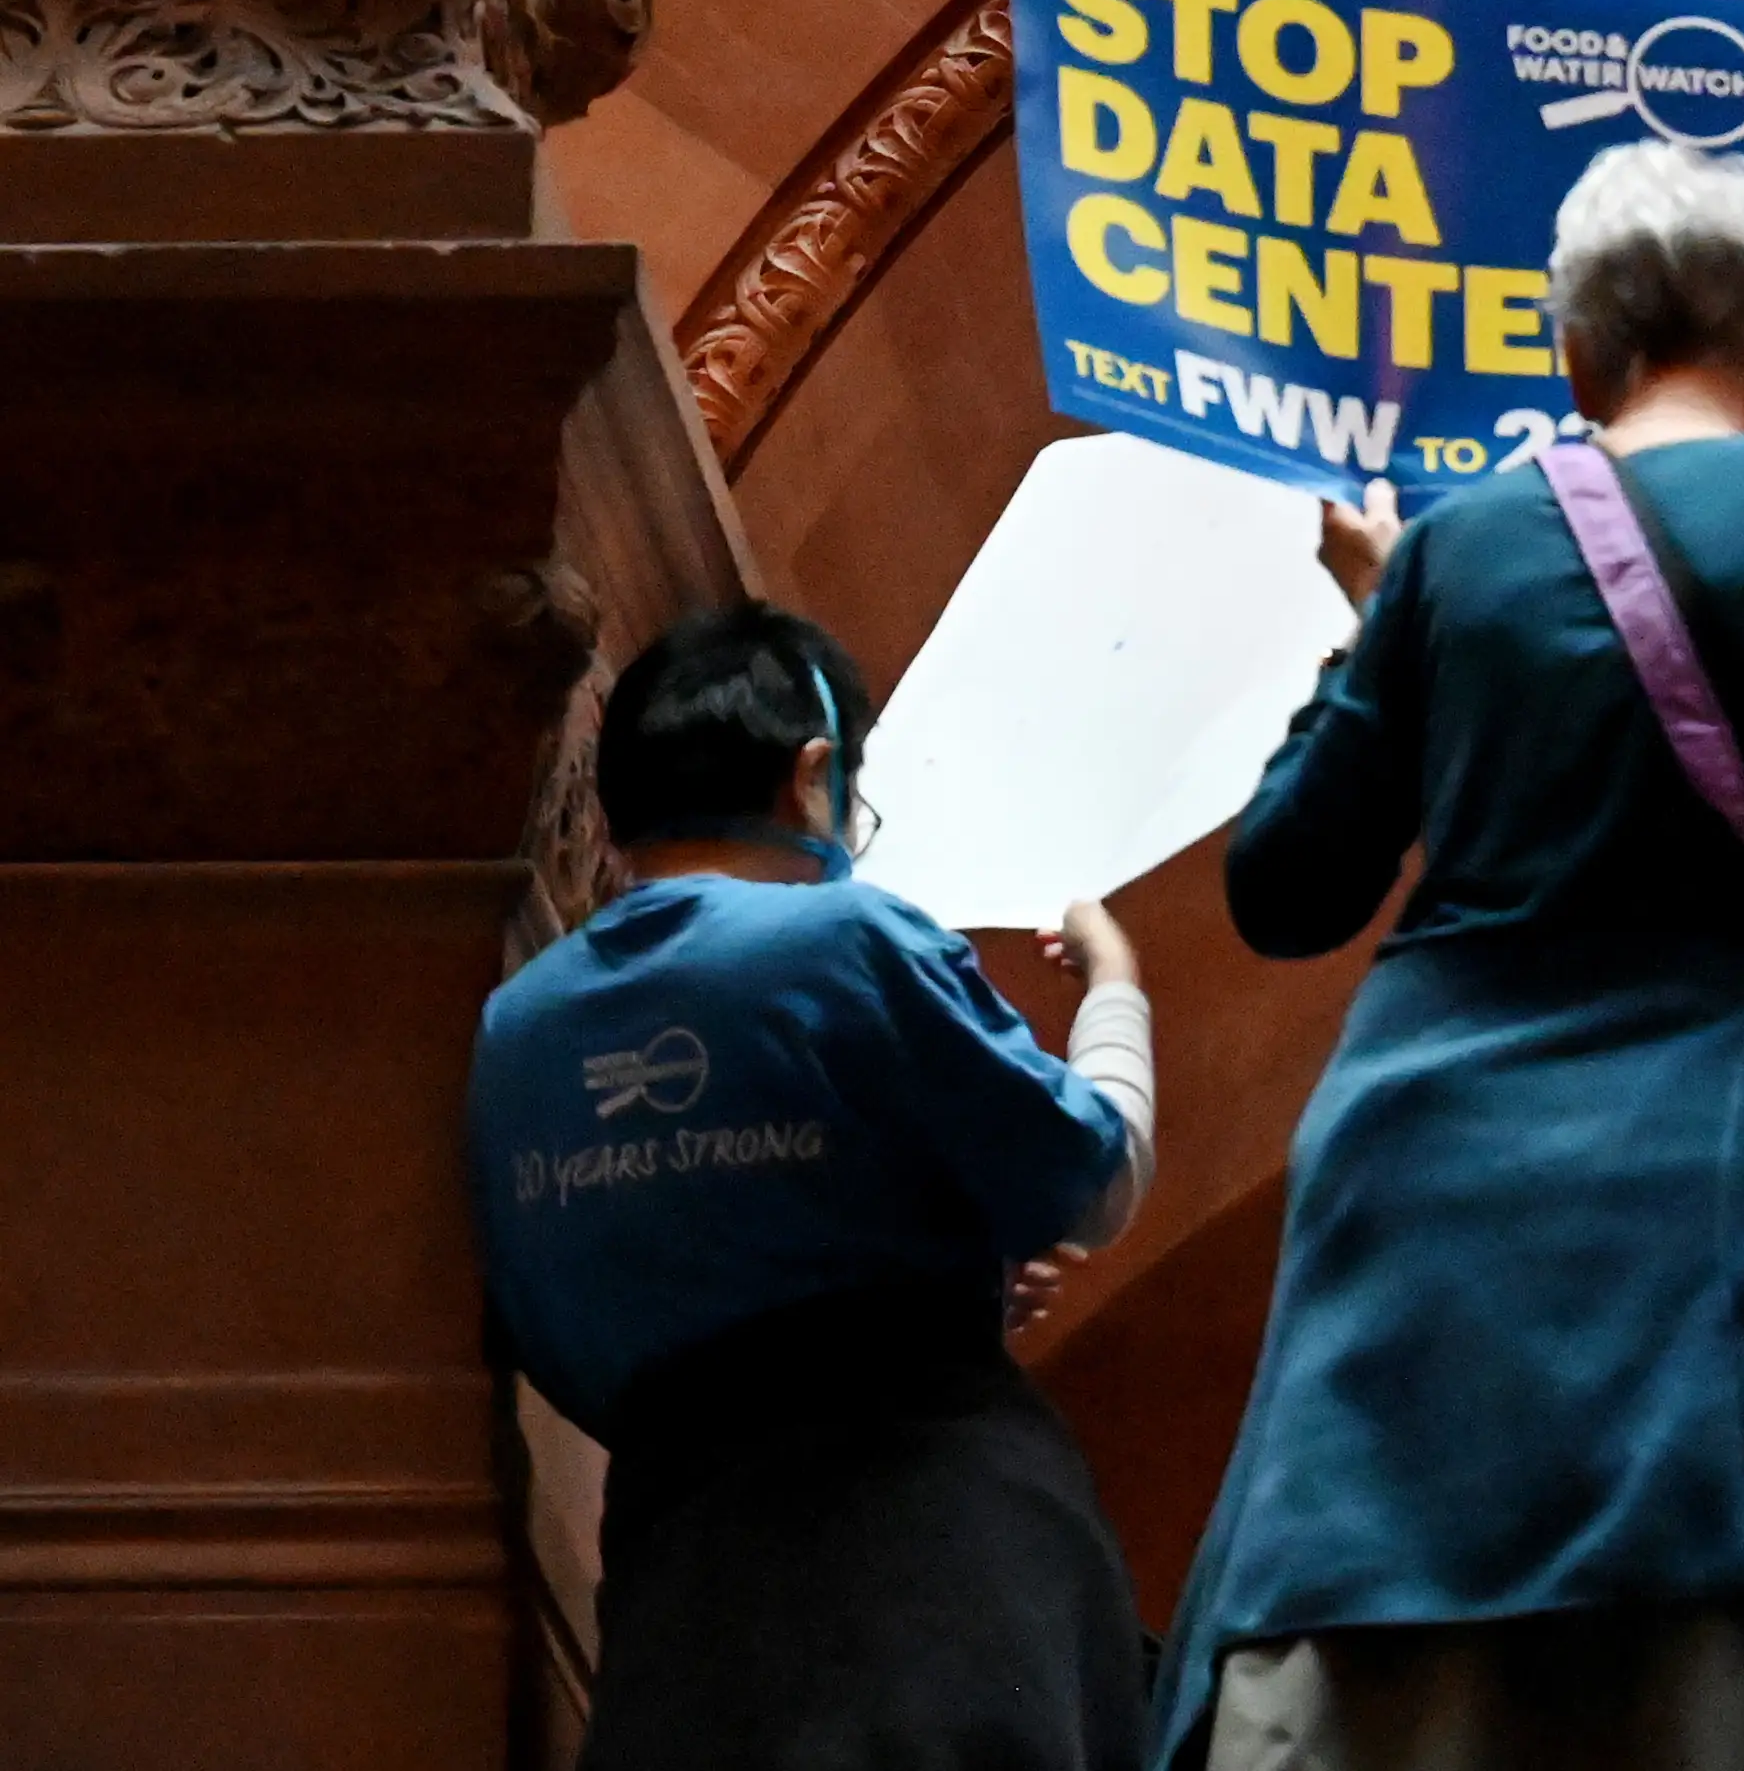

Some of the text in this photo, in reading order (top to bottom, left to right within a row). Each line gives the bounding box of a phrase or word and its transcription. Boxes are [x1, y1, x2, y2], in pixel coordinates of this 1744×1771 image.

[1506, 24, 1629, 59] FOOD&
[1512, 54, 1624, 89] WATER
[1057, 66, 1441, 247] DATA
[1066, 193, 1568, 378] CENTE
[1065, 339, 1170, 404] TEXT
[1174, 348, 1400, 471] FWW
[1413, 436, 1488, 473] TO
[553, 1138, 661, 1209] YEARS
[666, 1121, 824, 1173] STRONG
